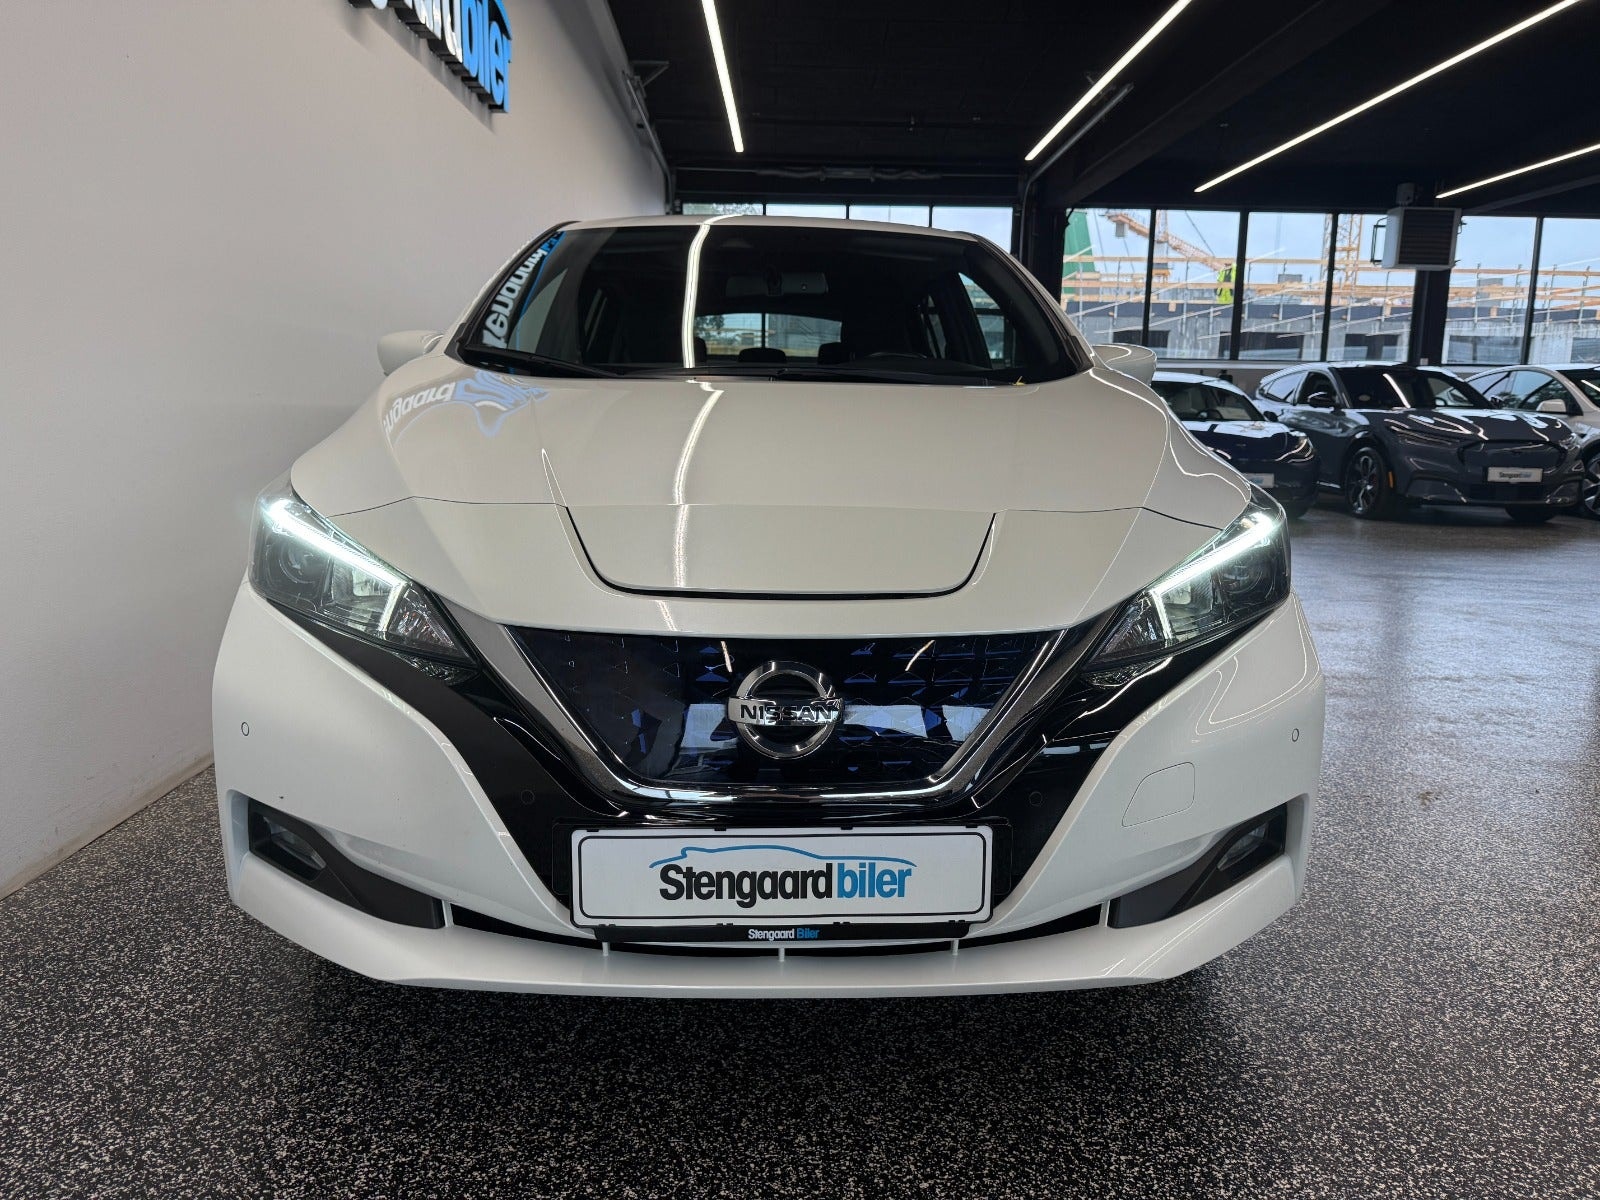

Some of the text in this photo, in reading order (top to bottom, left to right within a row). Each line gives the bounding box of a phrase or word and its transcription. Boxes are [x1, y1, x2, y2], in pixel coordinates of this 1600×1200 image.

[740, 704, 835, 721] NISSAN
[748, 927, 820, 941] Stengaard Biler
